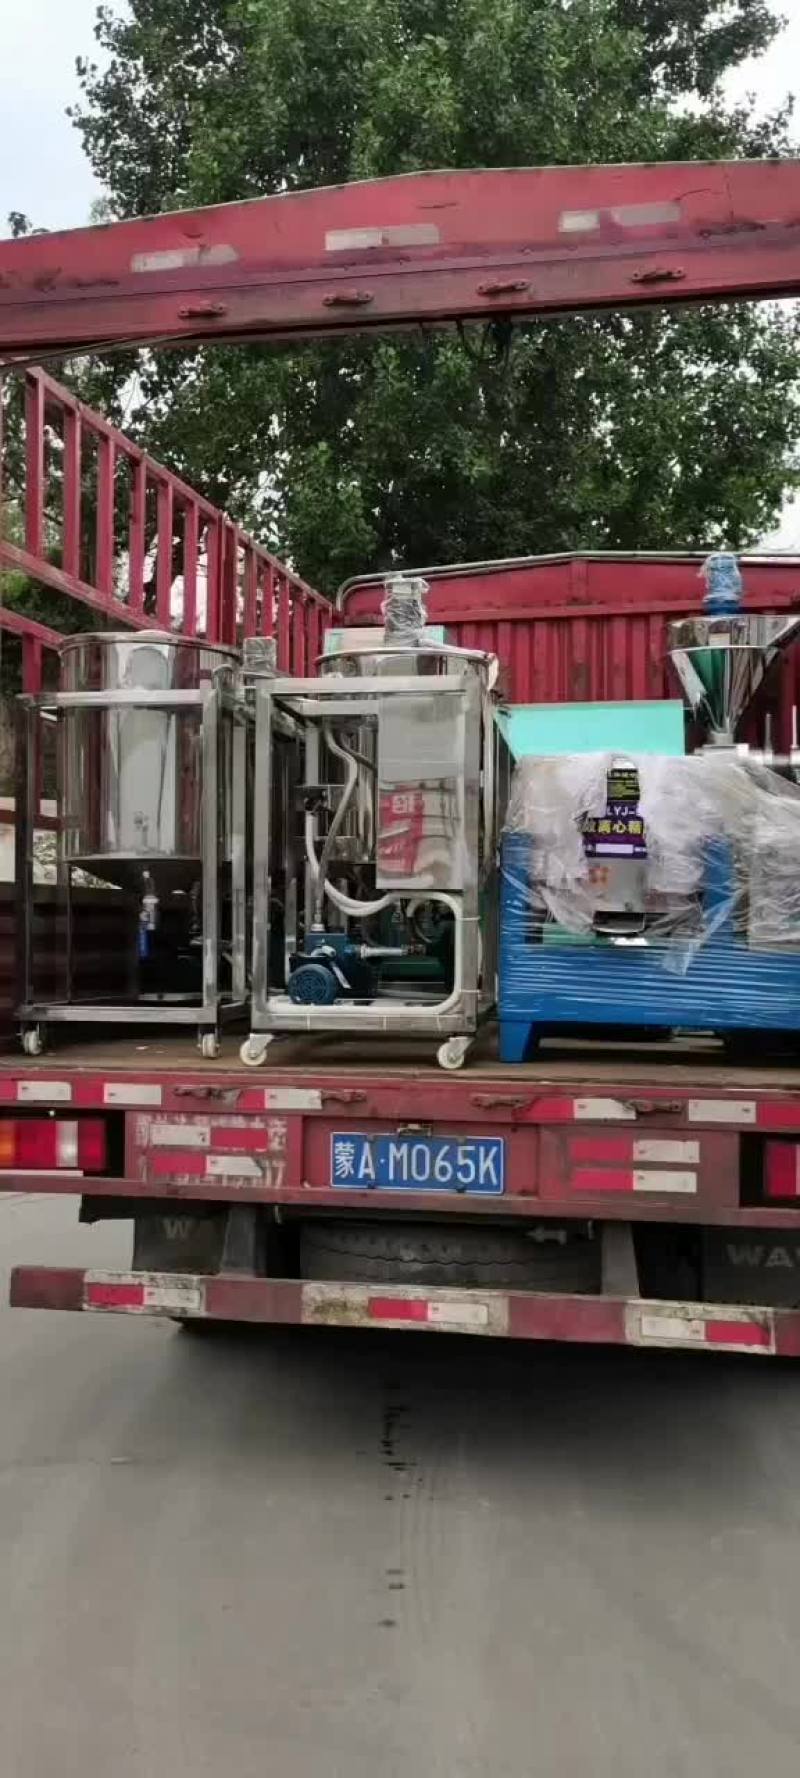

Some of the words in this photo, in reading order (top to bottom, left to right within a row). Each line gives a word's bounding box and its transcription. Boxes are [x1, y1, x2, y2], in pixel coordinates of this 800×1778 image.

[606, 805, 640, 816] LYJ-
[334, 1141, 499, 1186] 蒙A·M065K
[726, 1244, 800, 1268] WA
